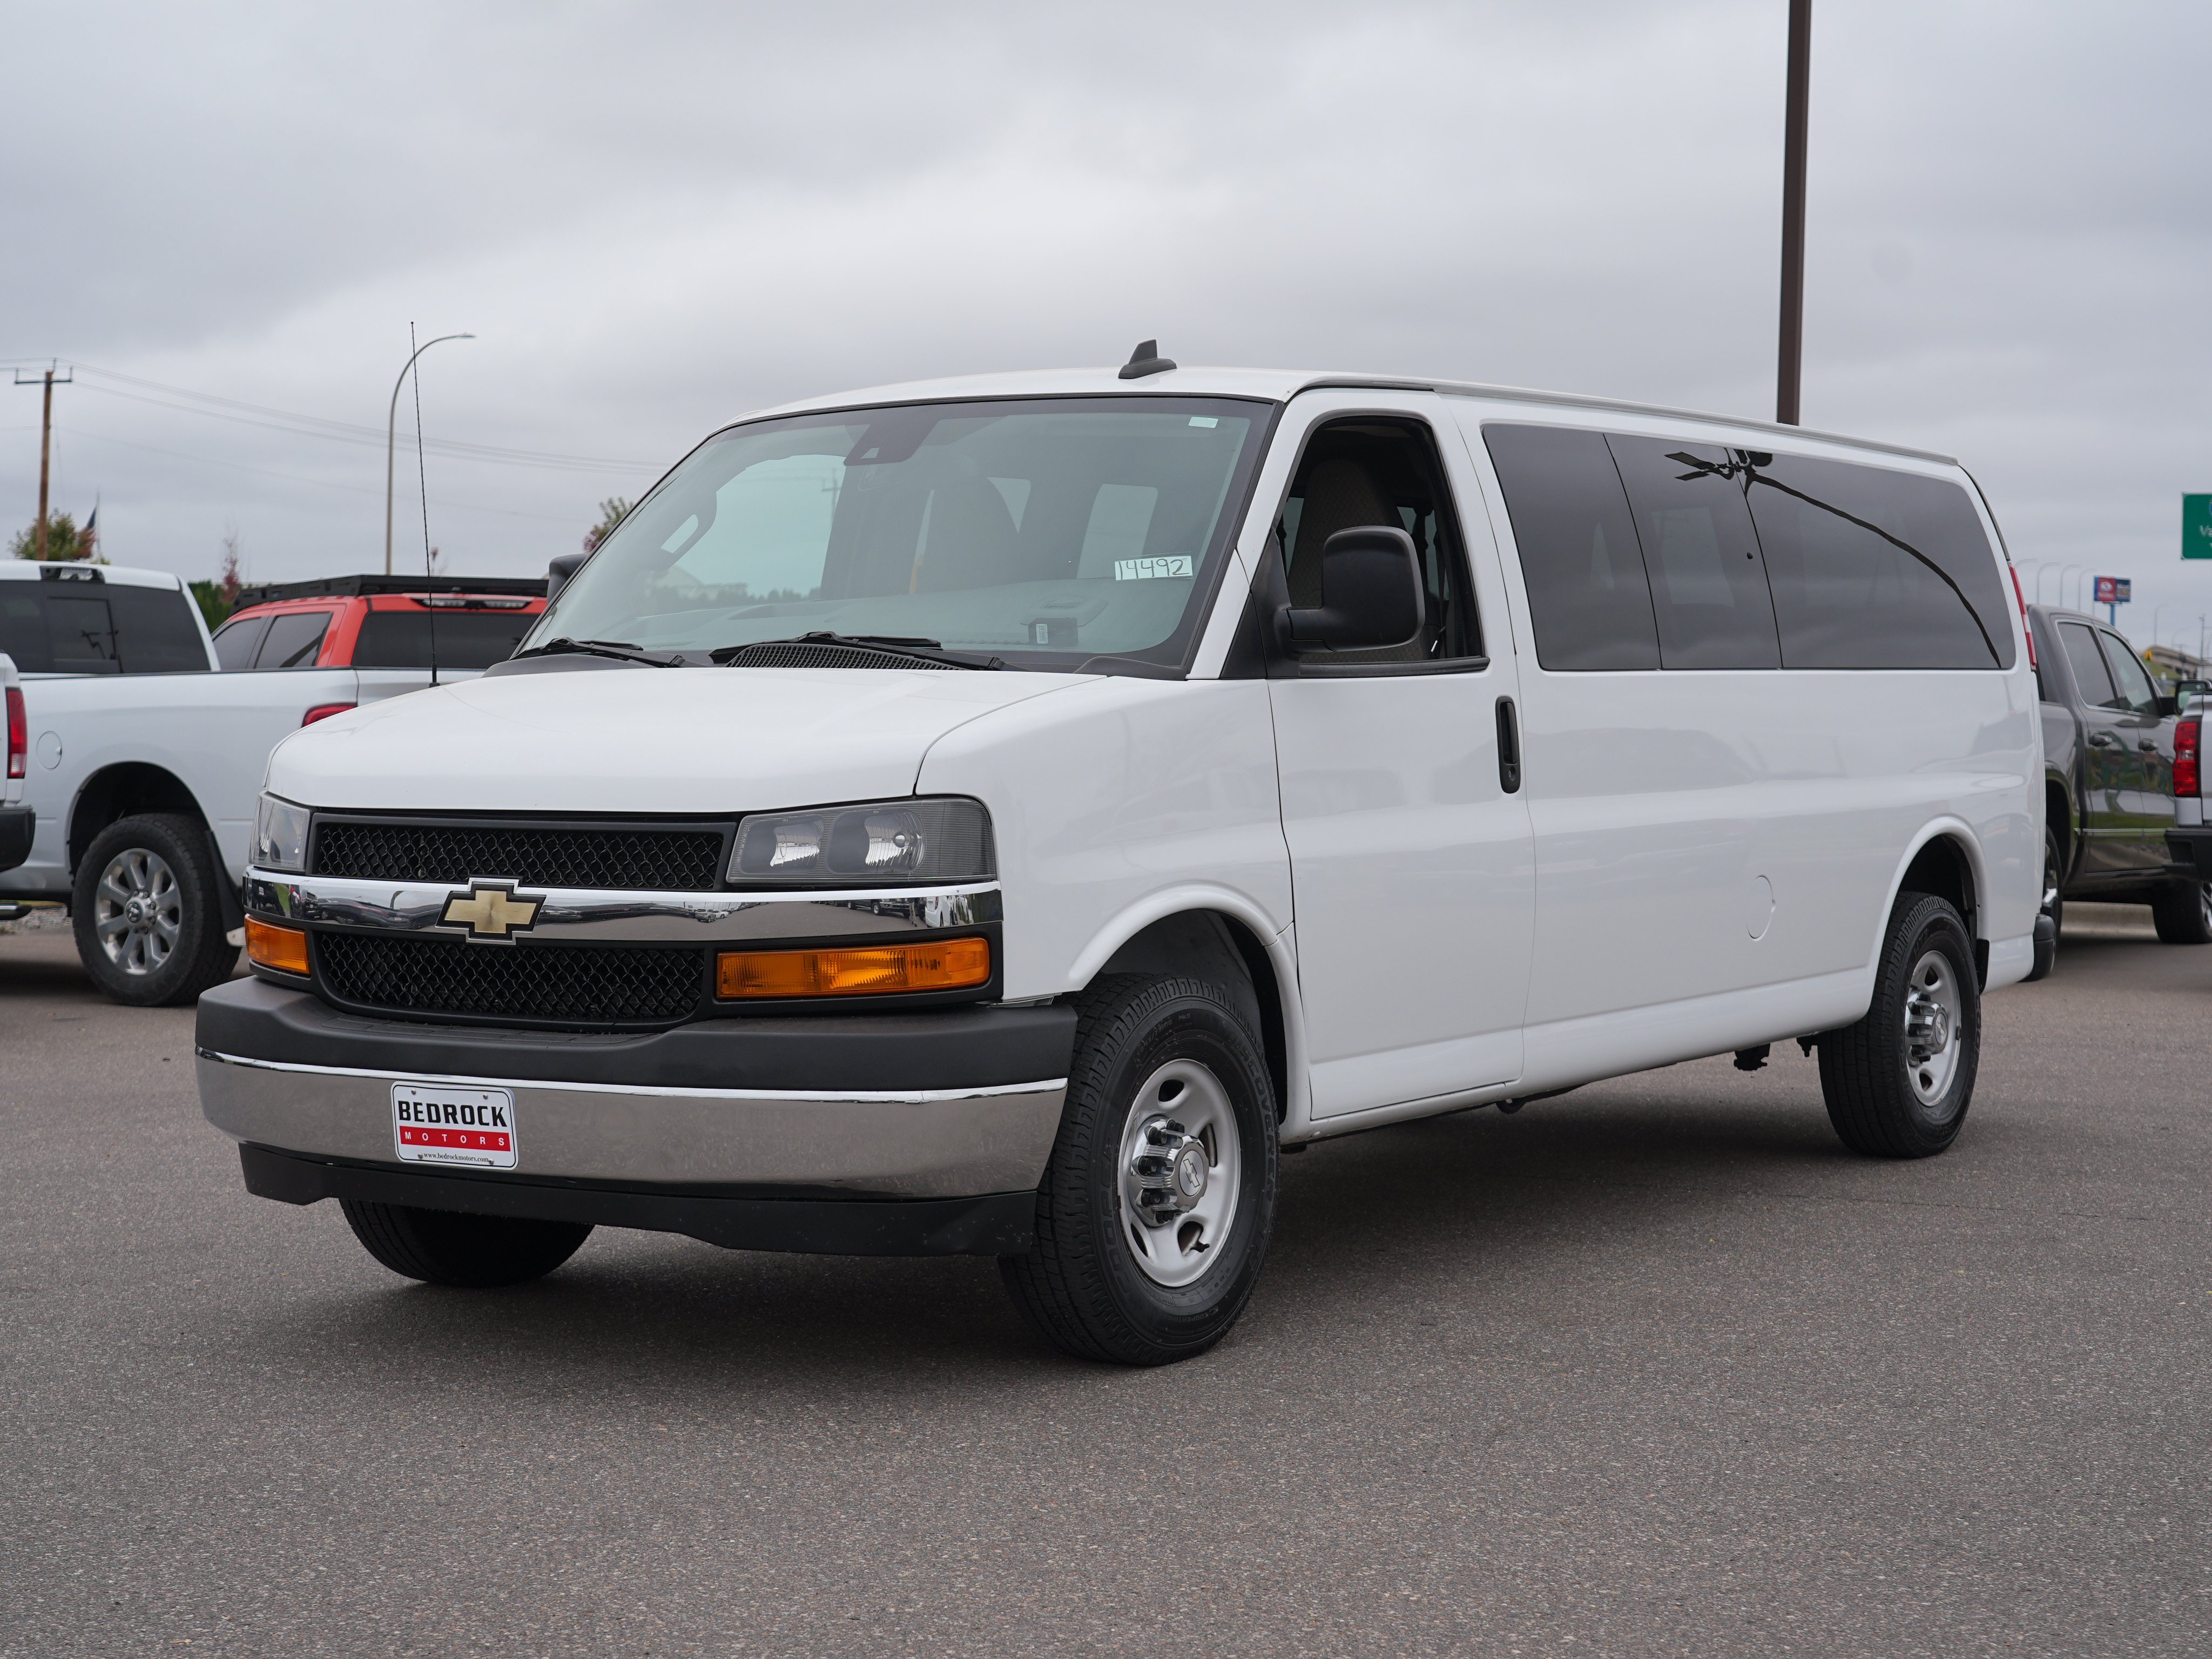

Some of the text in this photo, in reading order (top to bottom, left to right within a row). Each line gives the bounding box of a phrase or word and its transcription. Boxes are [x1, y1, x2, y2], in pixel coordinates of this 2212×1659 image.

[1118, 558, 1190, 579] 14492
[398, 1100, 507, 1127] BEDROCK
[405, 1131, 505, 1146] MOTORS
[423, 1152, 489, 1163] www.bedrockmotors.com
